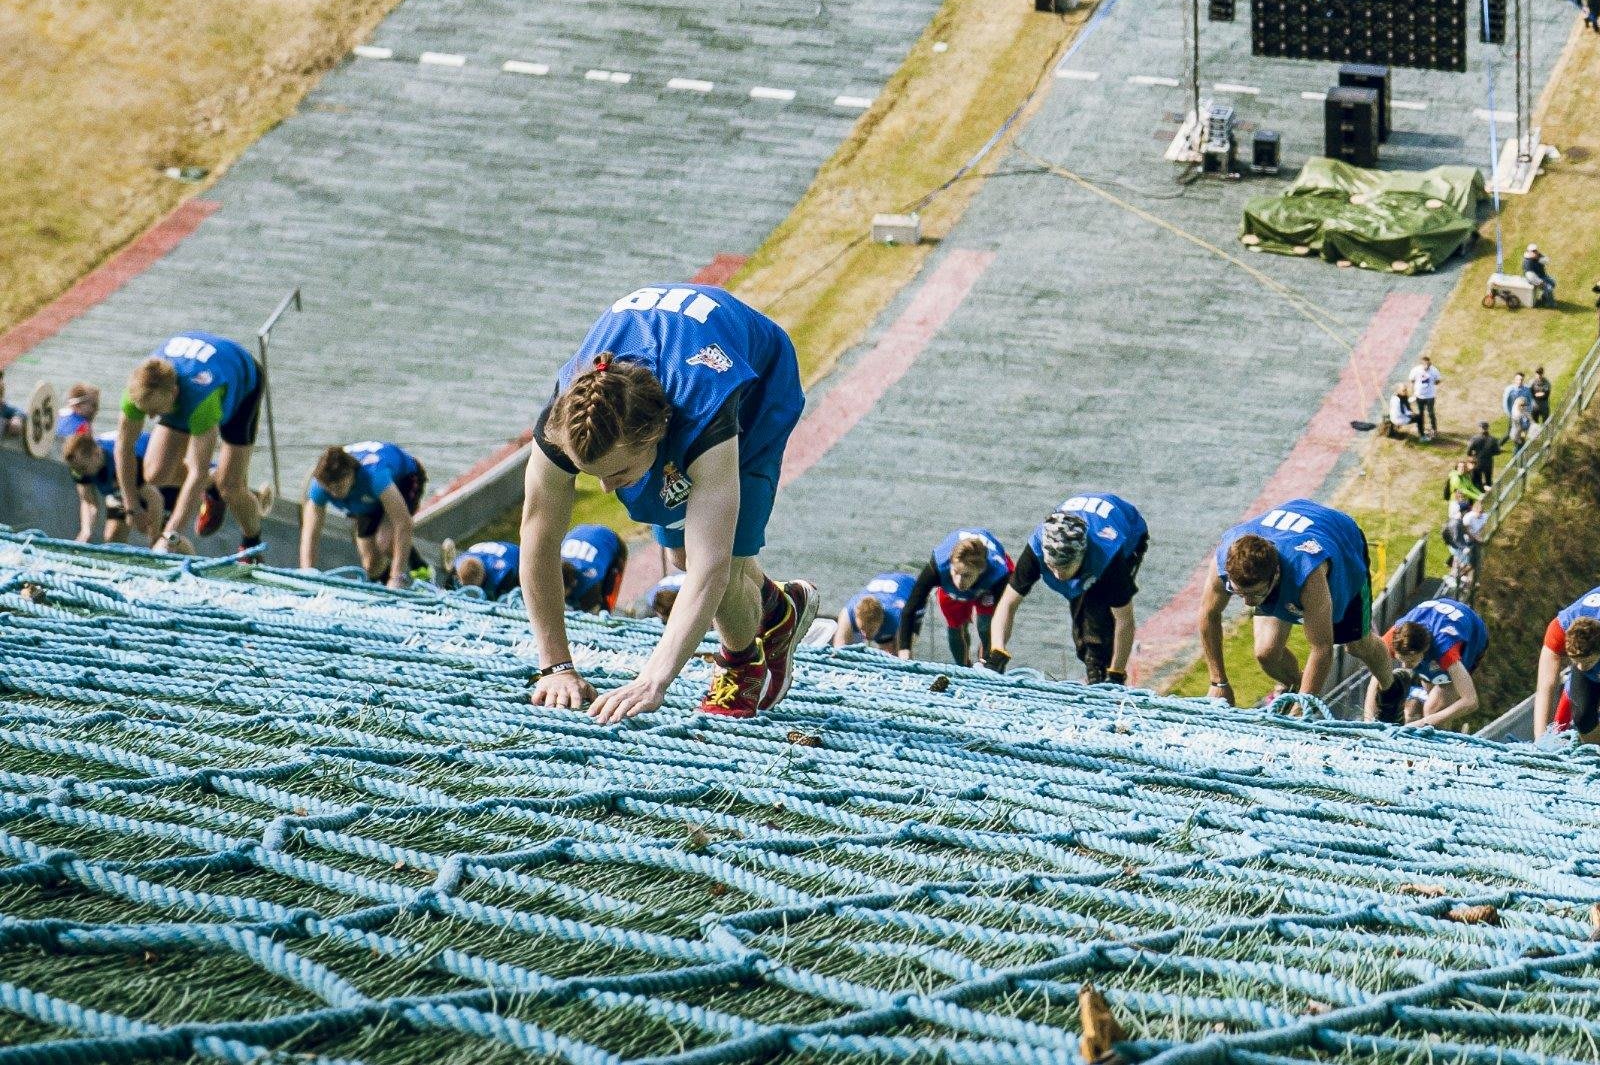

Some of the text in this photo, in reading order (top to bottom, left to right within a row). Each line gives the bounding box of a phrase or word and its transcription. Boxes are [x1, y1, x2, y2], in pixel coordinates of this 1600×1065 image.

[611, 287, 721, 324] 119
[32, 396, 52, 443] 85
[1260, 509, 1315, 534] 111
